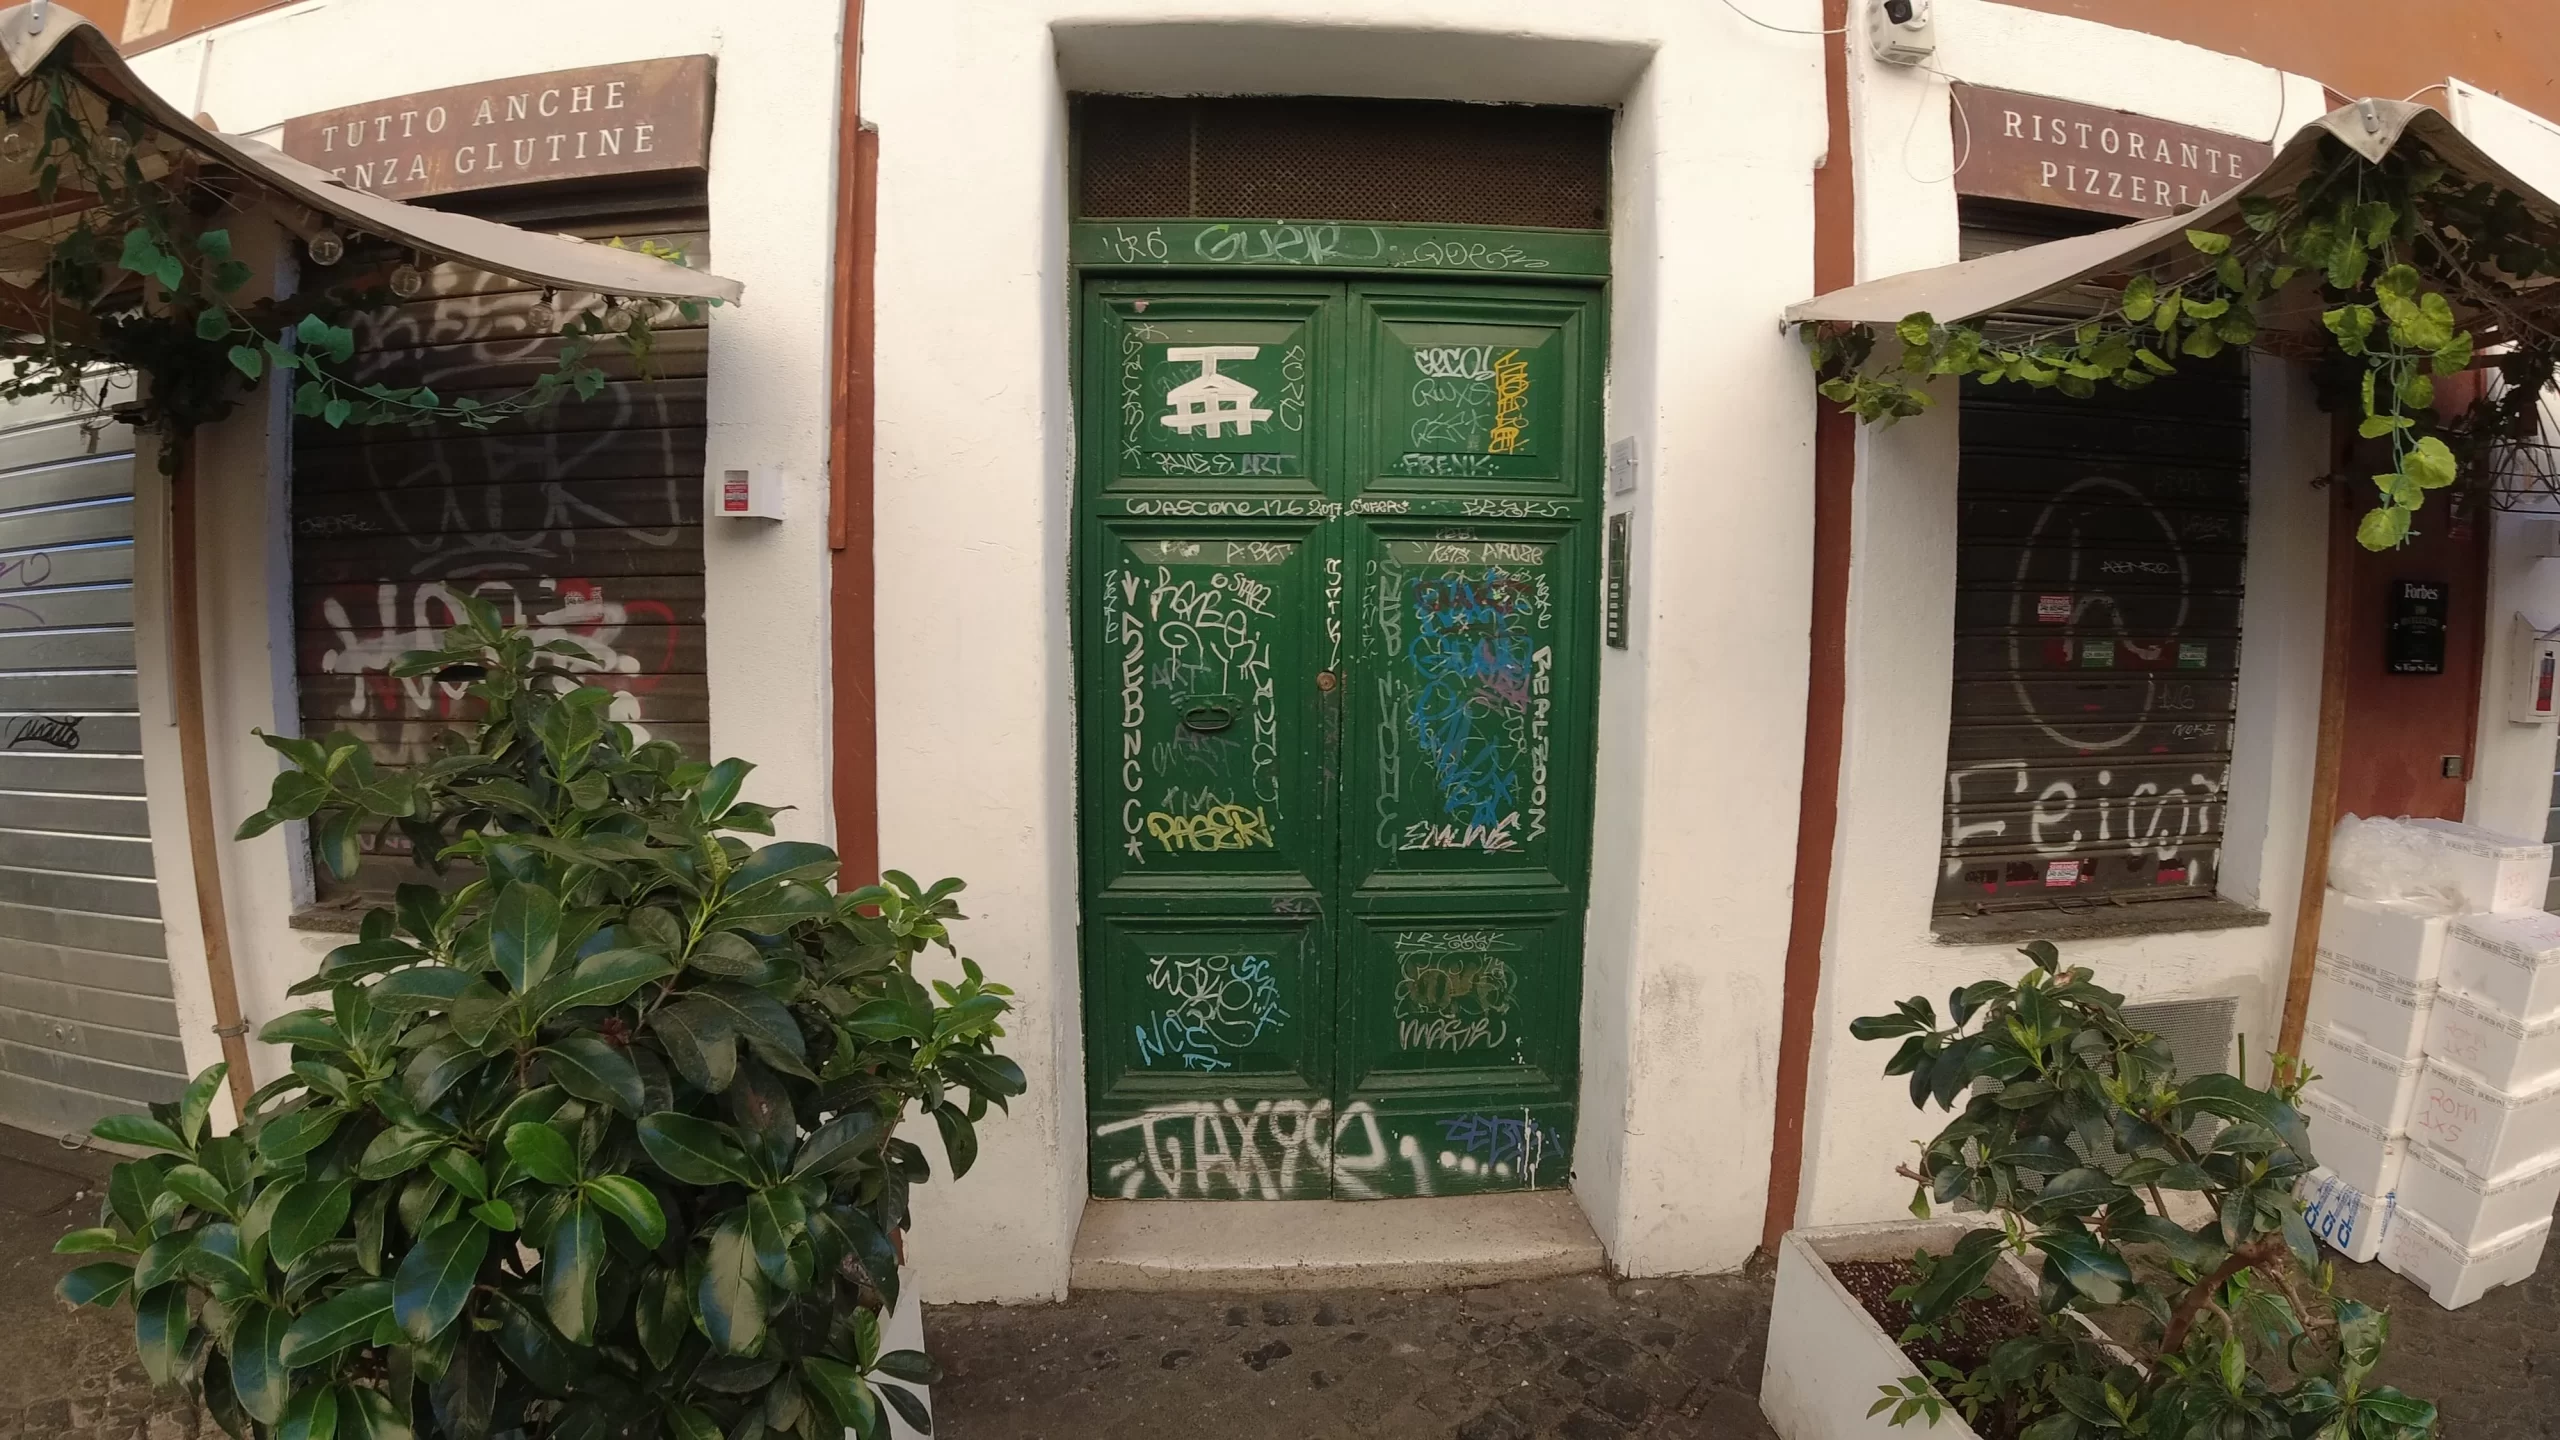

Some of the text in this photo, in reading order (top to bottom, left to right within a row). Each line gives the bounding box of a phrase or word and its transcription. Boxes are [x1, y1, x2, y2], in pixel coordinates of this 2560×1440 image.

[322, 80, 627, 153] TUTTO ANCHE
[454, 123, 656, 176] GLUTINE
[2002, 109, 2244, 180] RISTORANTE
[2040, 160, 2211, 208] PIZZERIA
[2403, 582, 2440, 601] Forbes
